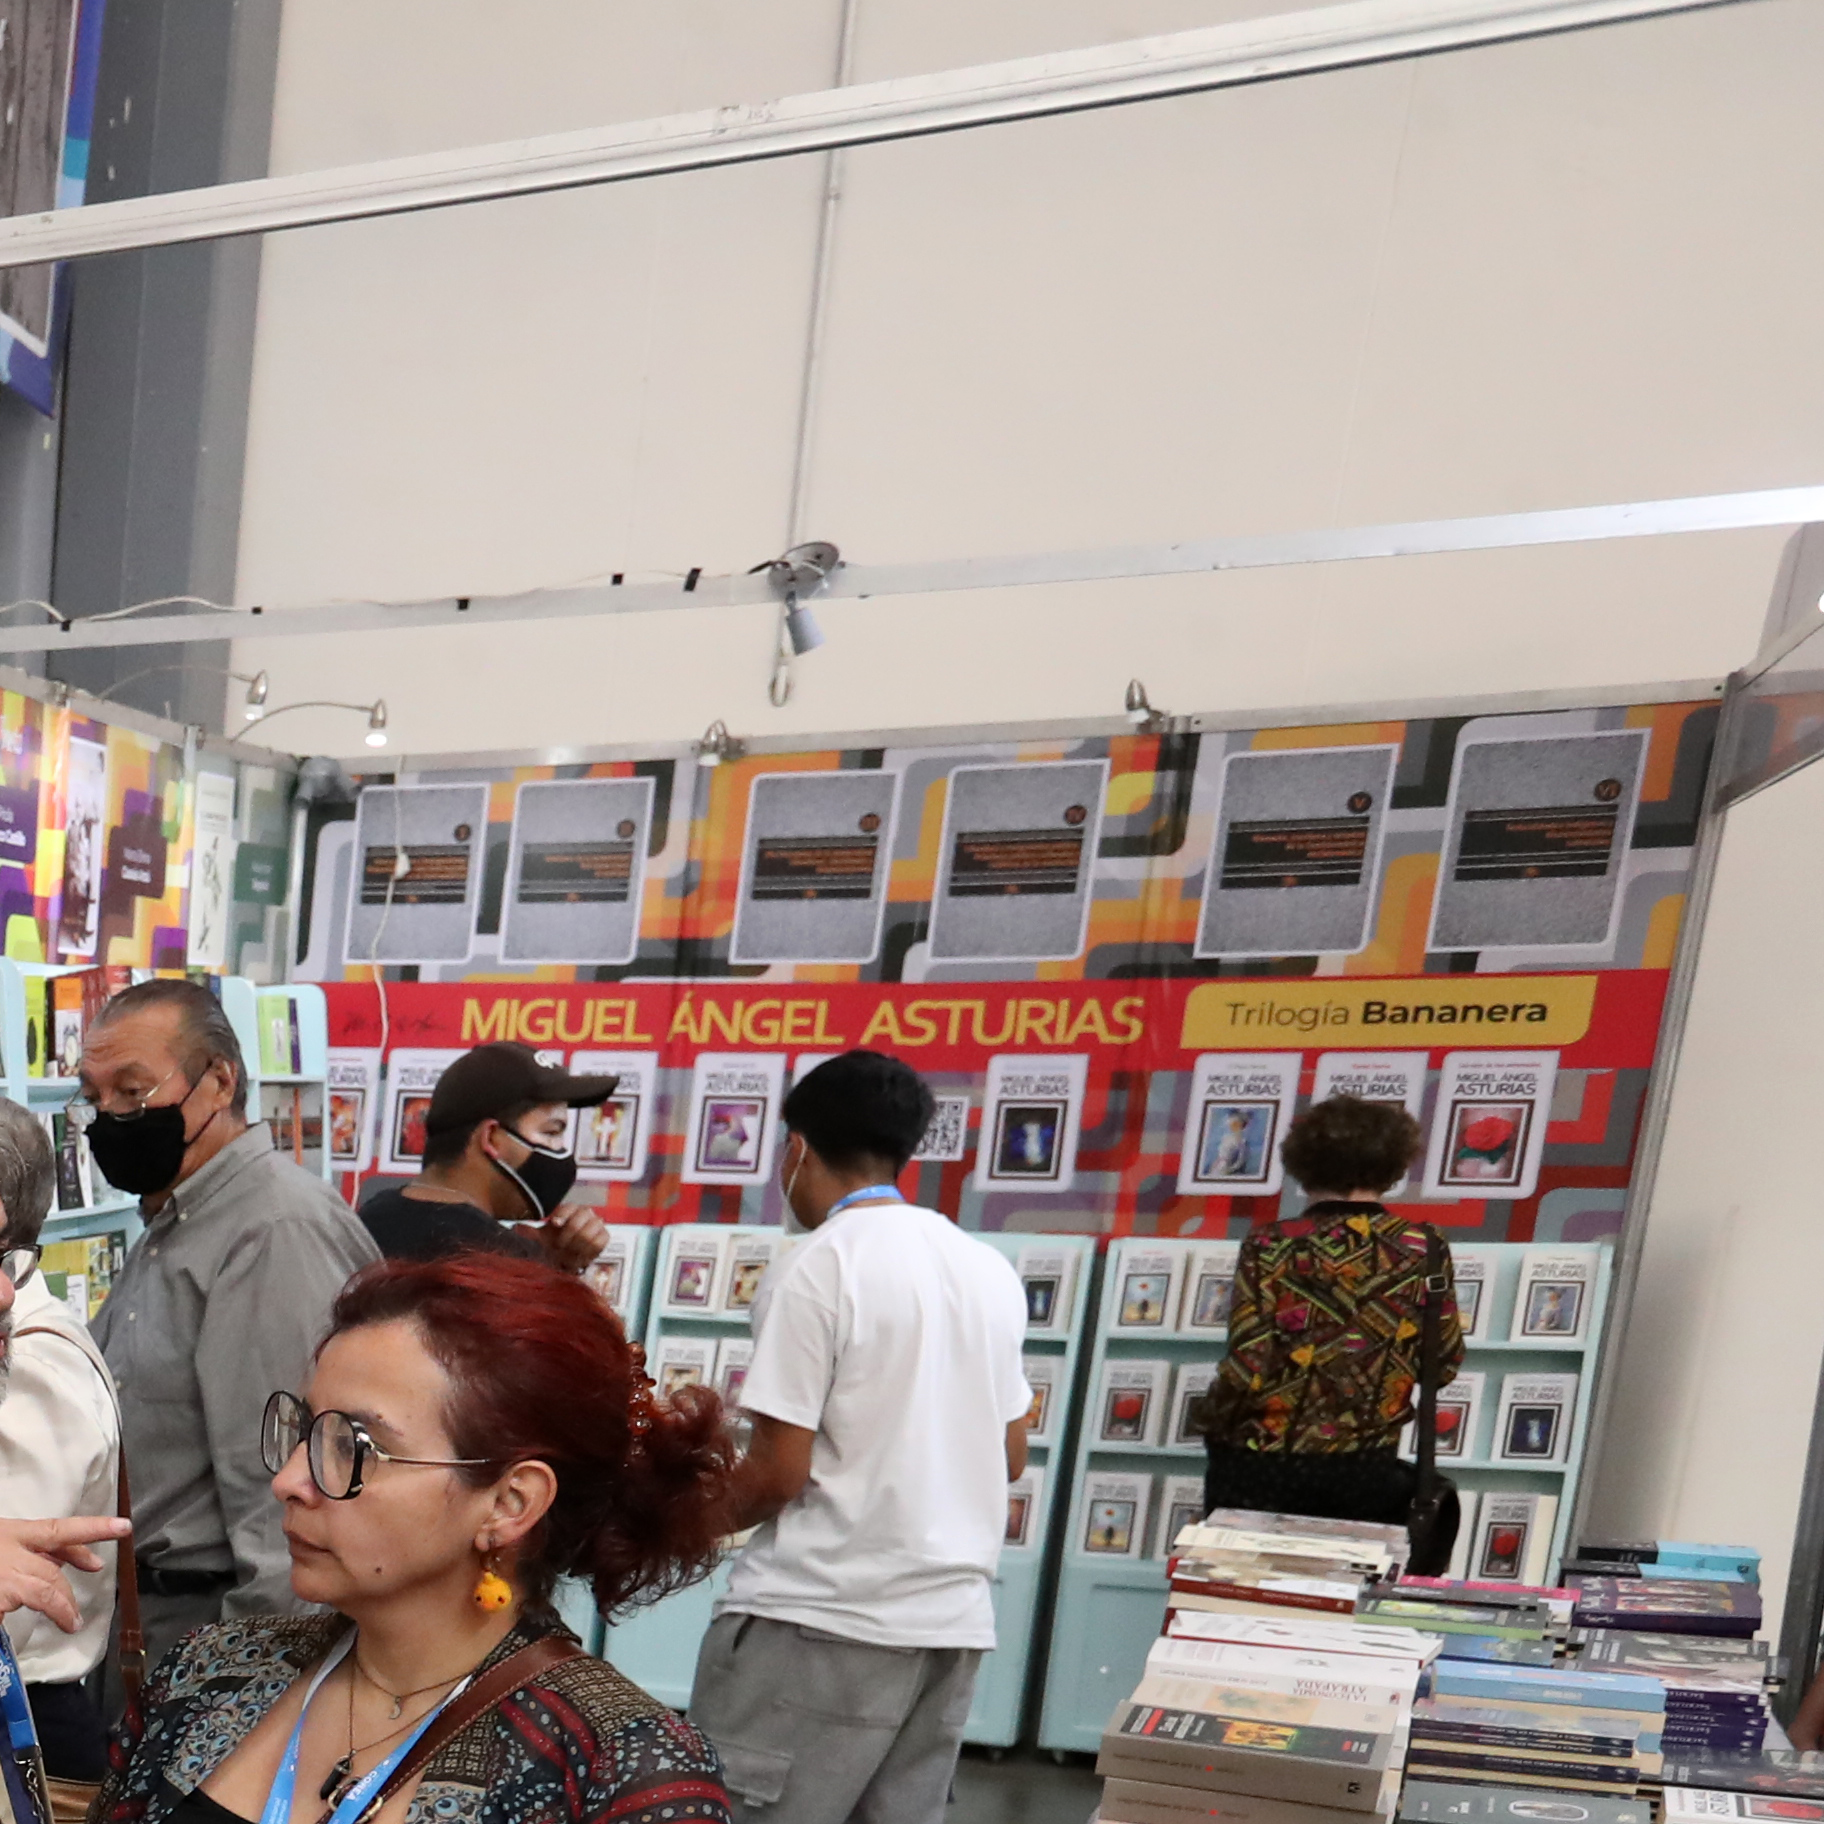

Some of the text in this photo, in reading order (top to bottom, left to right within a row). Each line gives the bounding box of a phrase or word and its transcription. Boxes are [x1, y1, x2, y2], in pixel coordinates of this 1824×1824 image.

[460, 991, 1144, 1046] MIGUEL ÁNGEL ASTURIAS
[1227, 999, 1547, 1031] Trilogía Bananera
[1454, 1083, 1536, 1095] ASTURIAS
[344, 1771, 378, 1800] COREA
